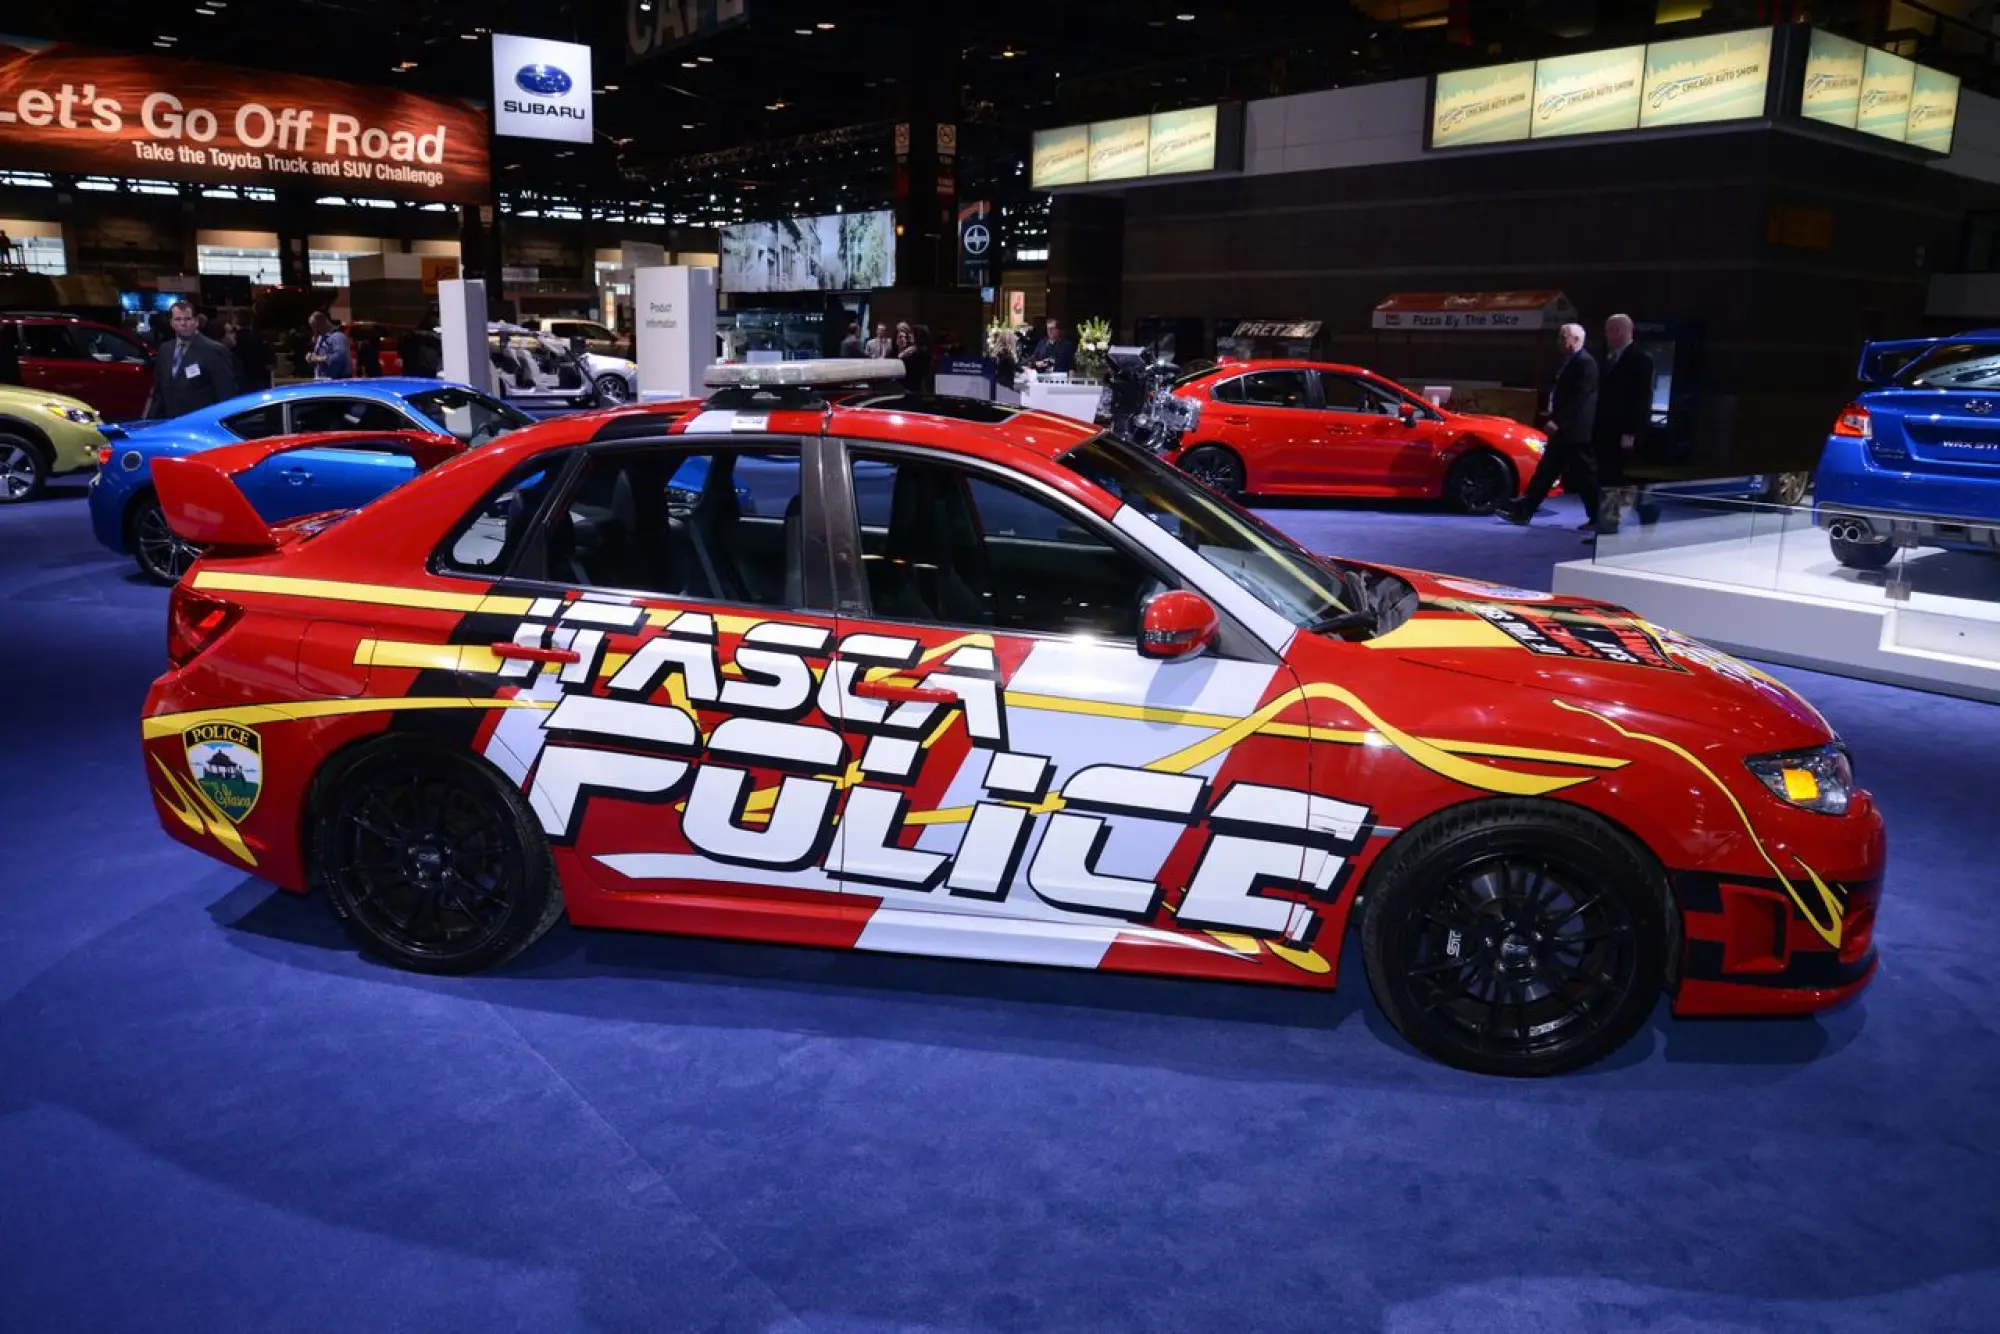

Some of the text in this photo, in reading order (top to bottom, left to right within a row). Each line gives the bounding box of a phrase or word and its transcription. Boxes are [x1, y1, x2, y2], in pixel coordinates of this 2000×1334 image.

[1715, 71, 1735, 82] AUTO
[1735, 64, 1759, 77] SHOW
[503, 99, 586, 120] SUBARU
[140, 91, 218, 143] Go
[235, 102, 314, 151] Off
[325, 112, 447, 165] Road
[132, 141, 445, 188] Take the Toyota Truck and SUV Challenge
[1413, 315, 1442, 326] Pizza
[1444, 315, 1460, 328] By
[1464, 315, 1487, 326] The
[1491, 314, 1520, 326] Slice
[497, 595, 1010, 750] ITASCA
[192, 725, 251, 744] POLICE
[528, 693, 1378, 951] POLICE
